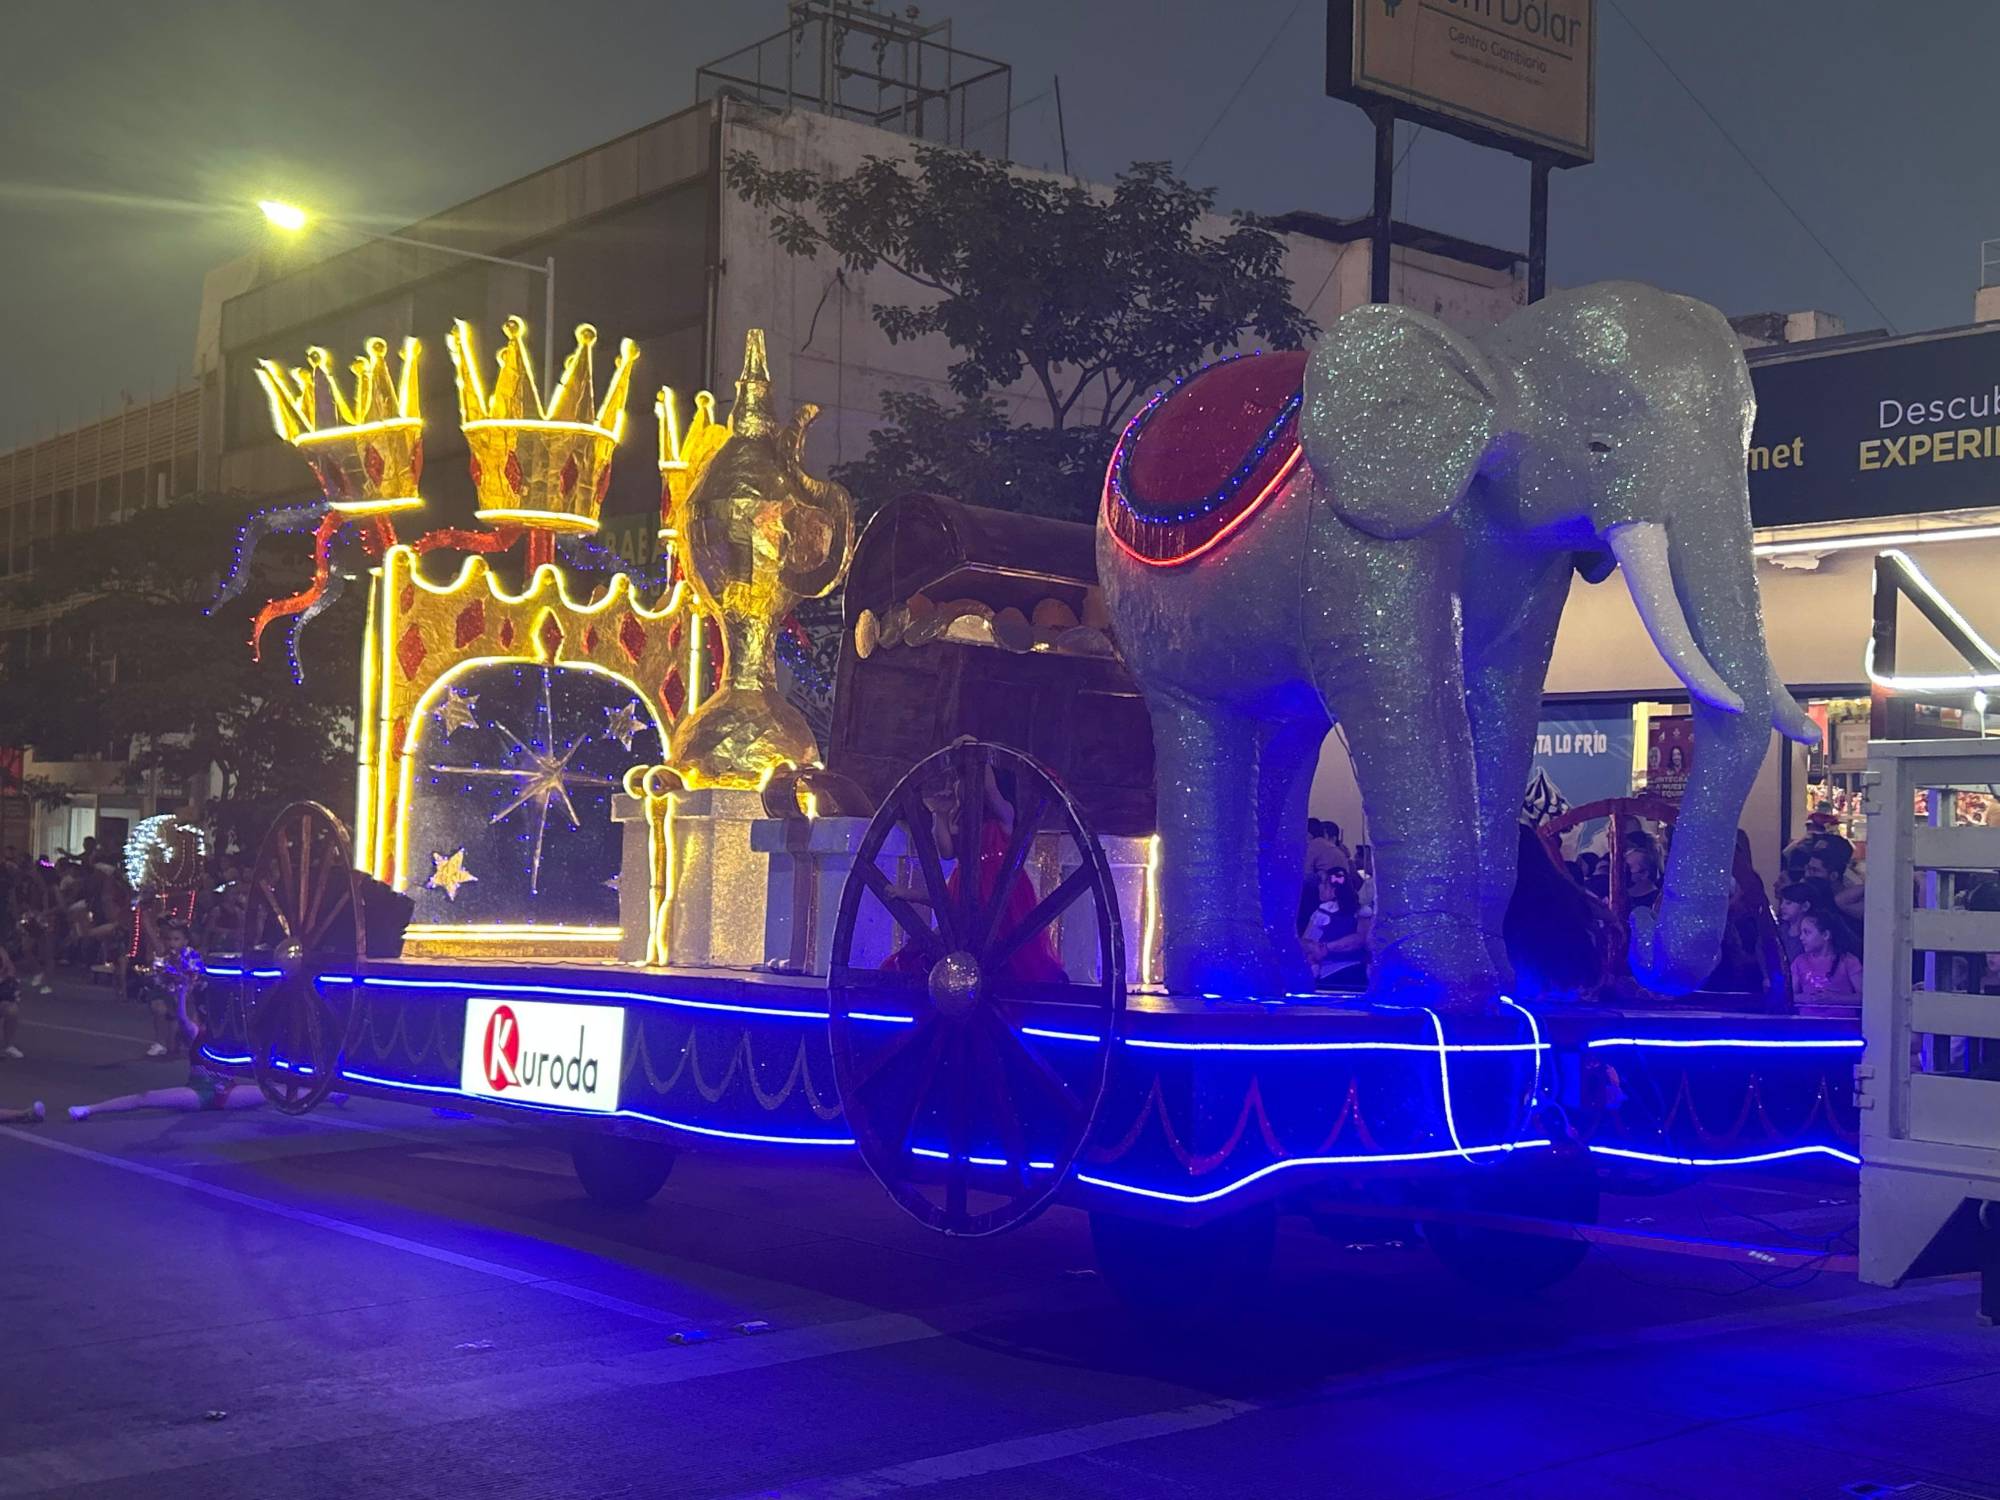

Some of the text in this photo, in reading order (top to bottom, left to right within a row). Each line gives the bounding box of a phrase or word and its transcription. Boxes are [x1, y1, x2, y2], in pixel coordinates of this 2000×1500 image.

[1448, 26, 1488, 53] Centro
[1490, 41, 1547, 74] Cambiario
[1860, 425, 2000, 470] EXPERI
[1533, 730, 1607, 757] TA LO FRÍO
[490, 1013, 598, 1094] Kuroda
